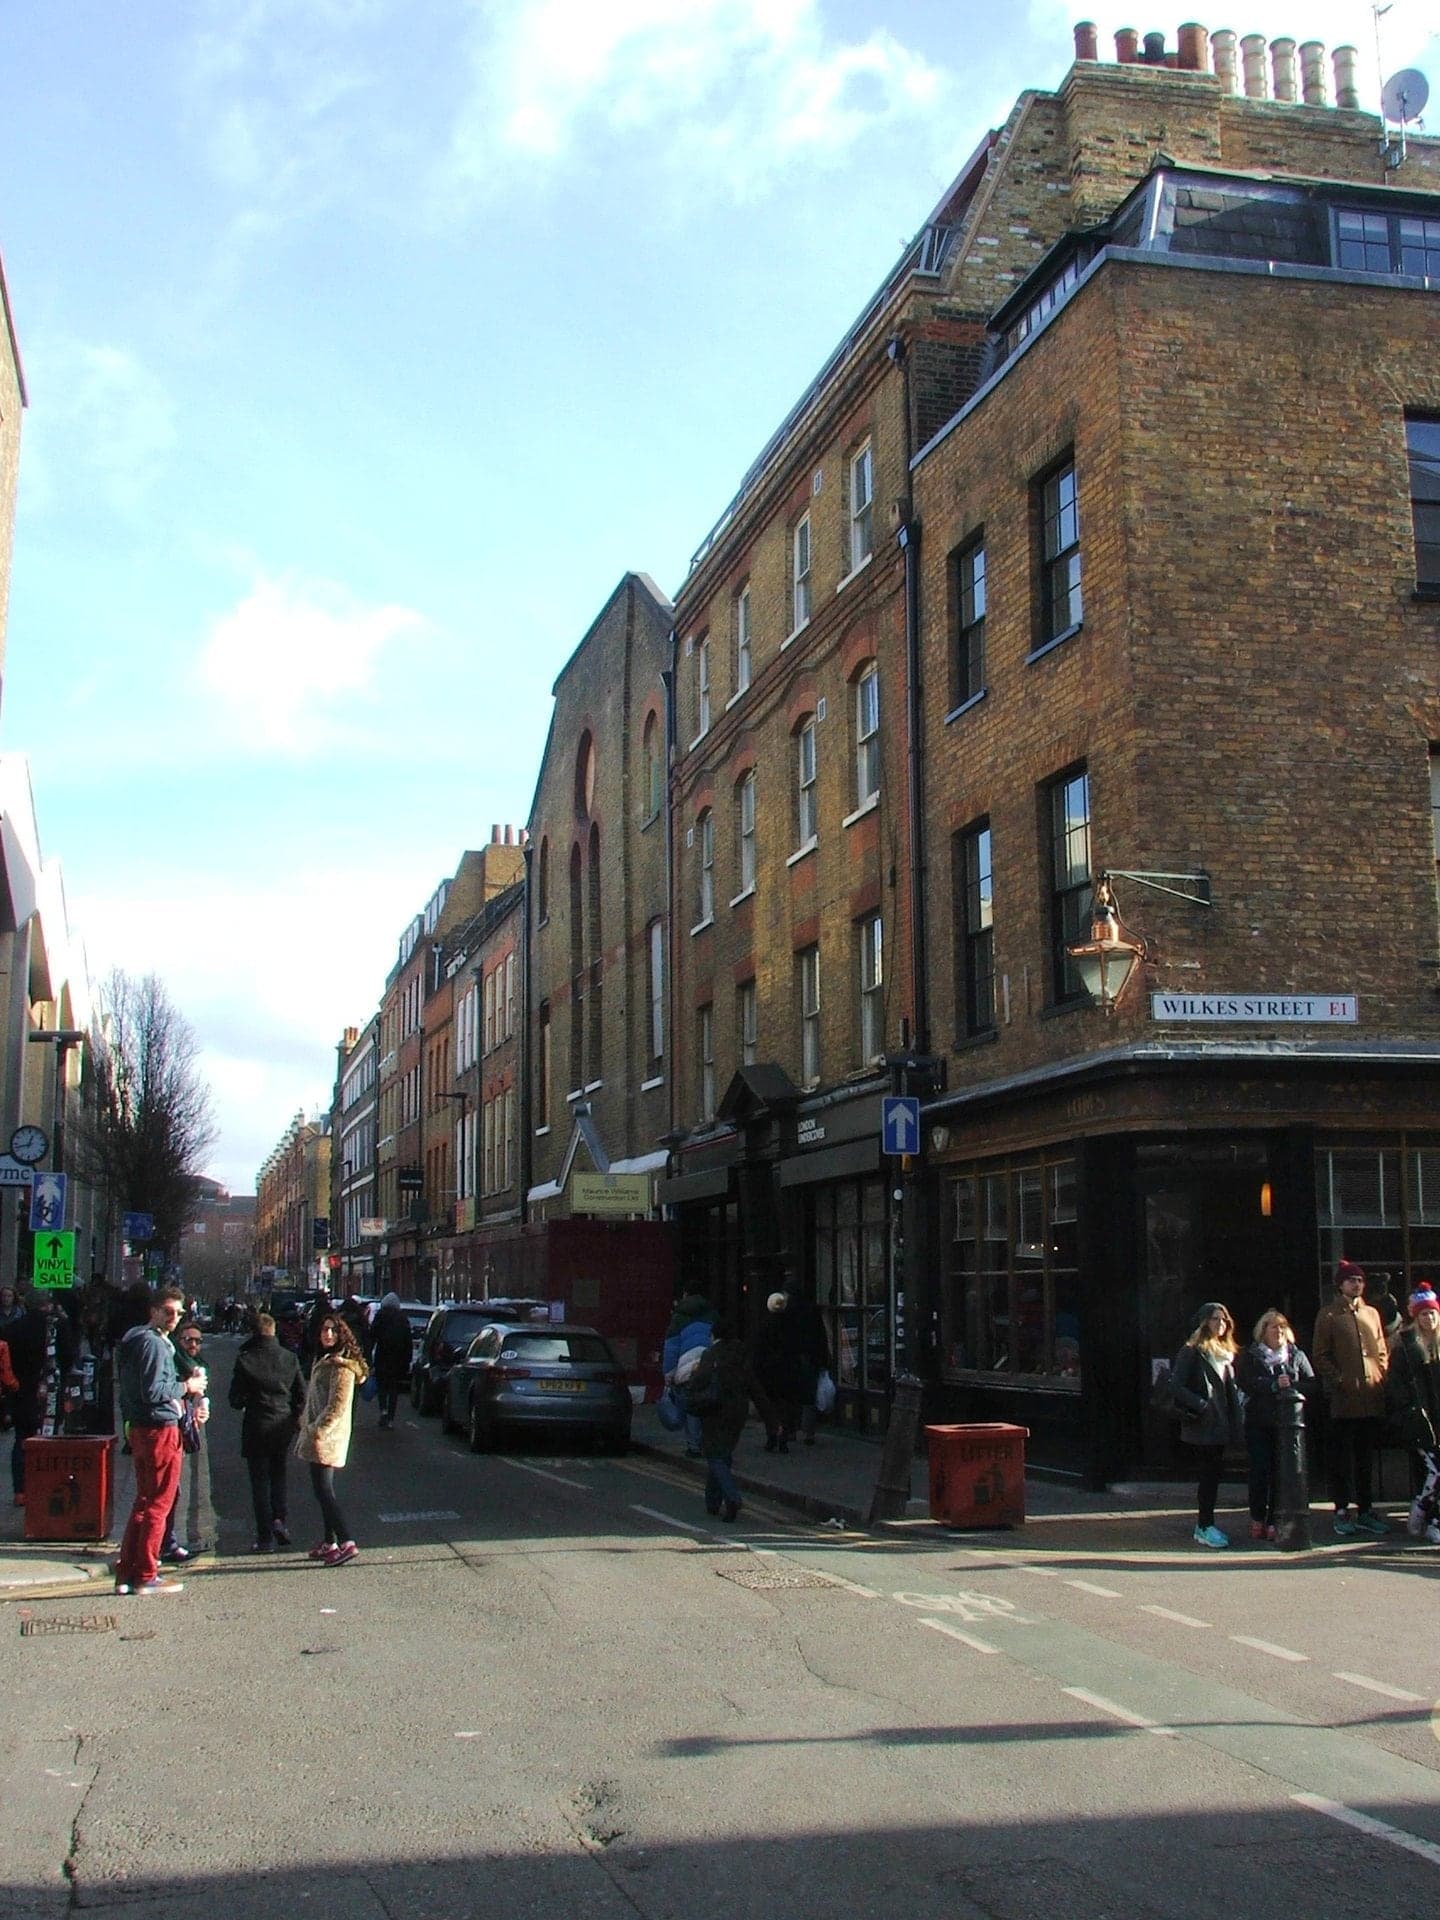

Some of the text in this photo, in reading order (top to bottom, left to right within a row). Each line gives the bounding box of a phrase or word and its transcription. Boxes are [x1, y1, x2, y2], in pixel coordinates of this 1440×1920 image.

[1163, 1000, 1346, 1016] WILKES STREET E1
[37, 1258, 72, 1271] VINYL
[40, 1273, 73, 1285] SALE
[960, 1444, 1013, 1462] LITTER
[36, 1456, 92, 1472] LITTER
